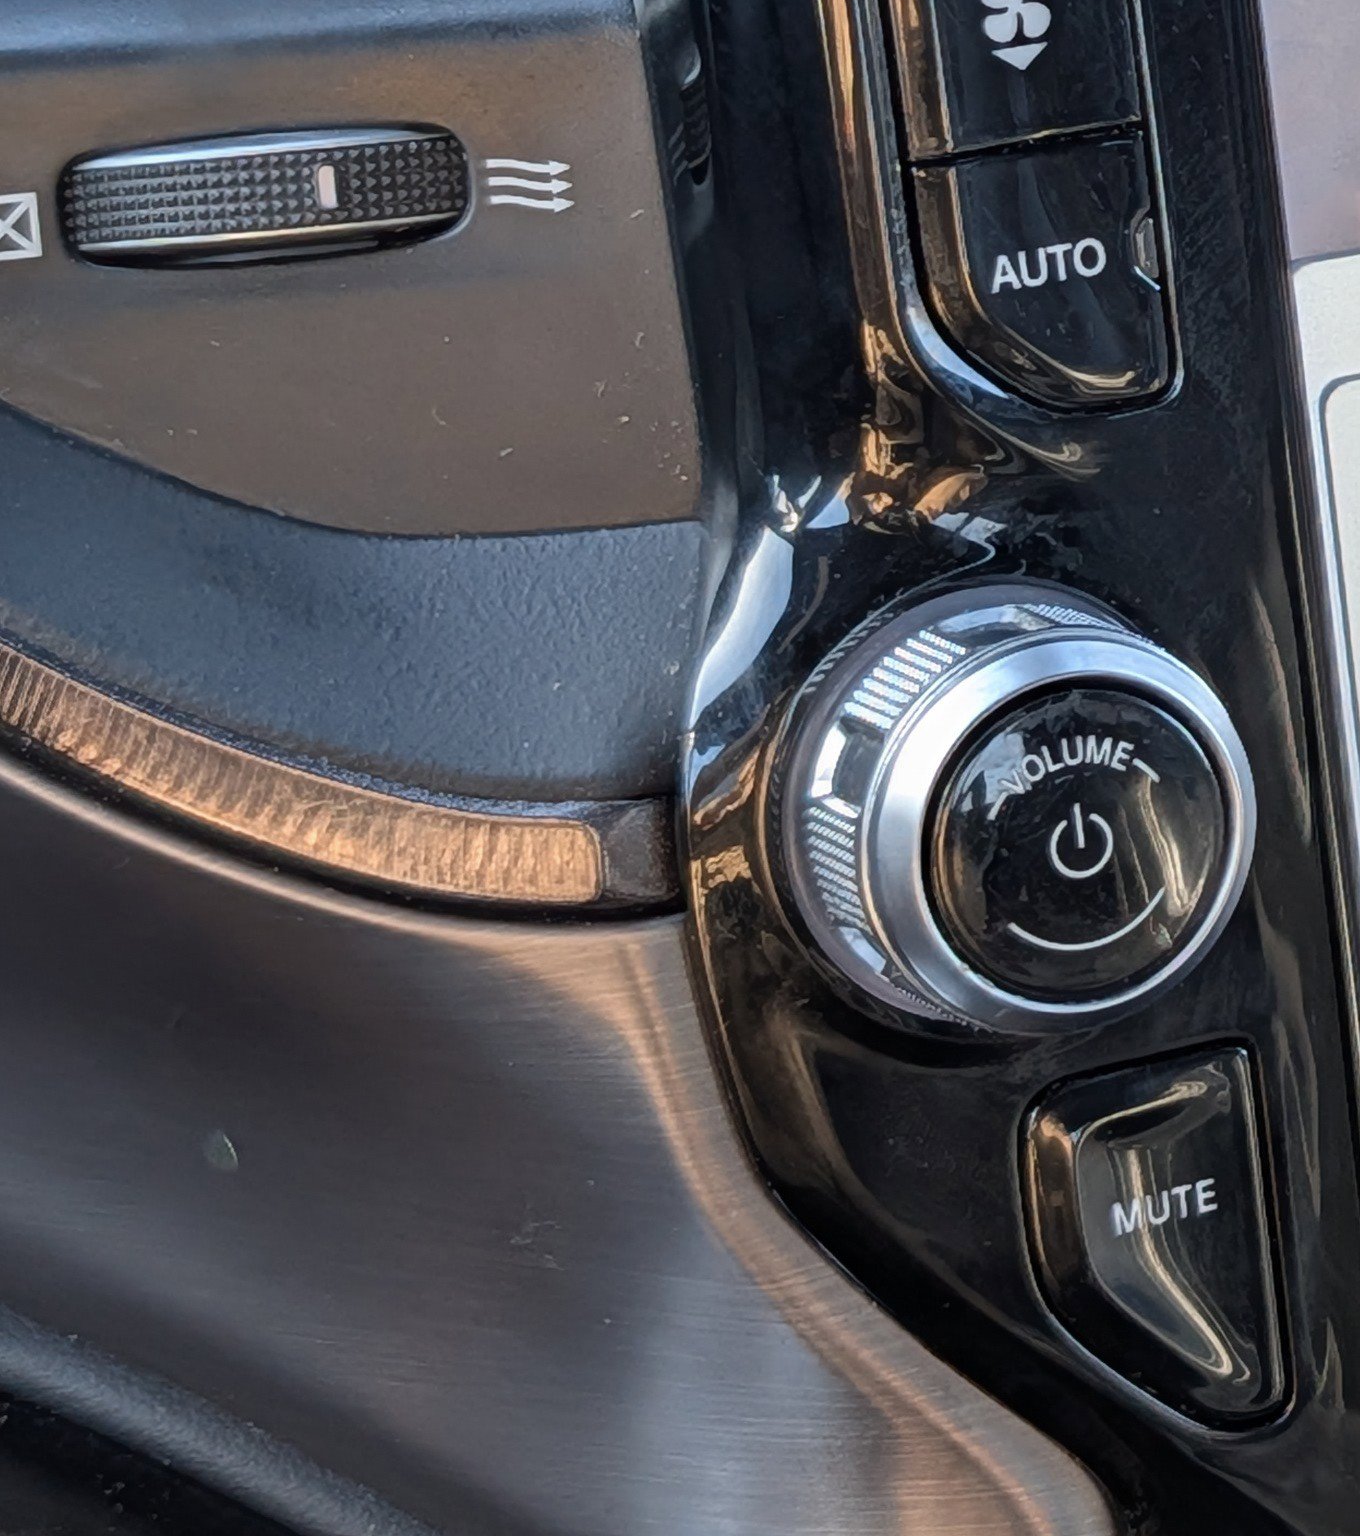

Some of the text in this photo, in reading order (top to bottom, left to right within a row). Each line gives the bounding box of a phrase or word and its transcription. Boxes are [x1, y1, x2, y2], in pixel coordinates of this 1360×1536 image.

[991, 237, 1106, 294] AUTO
[1000, 736, 1136, 796] VOLUME
[1110, 1178, 1218, 1238] MUTE
